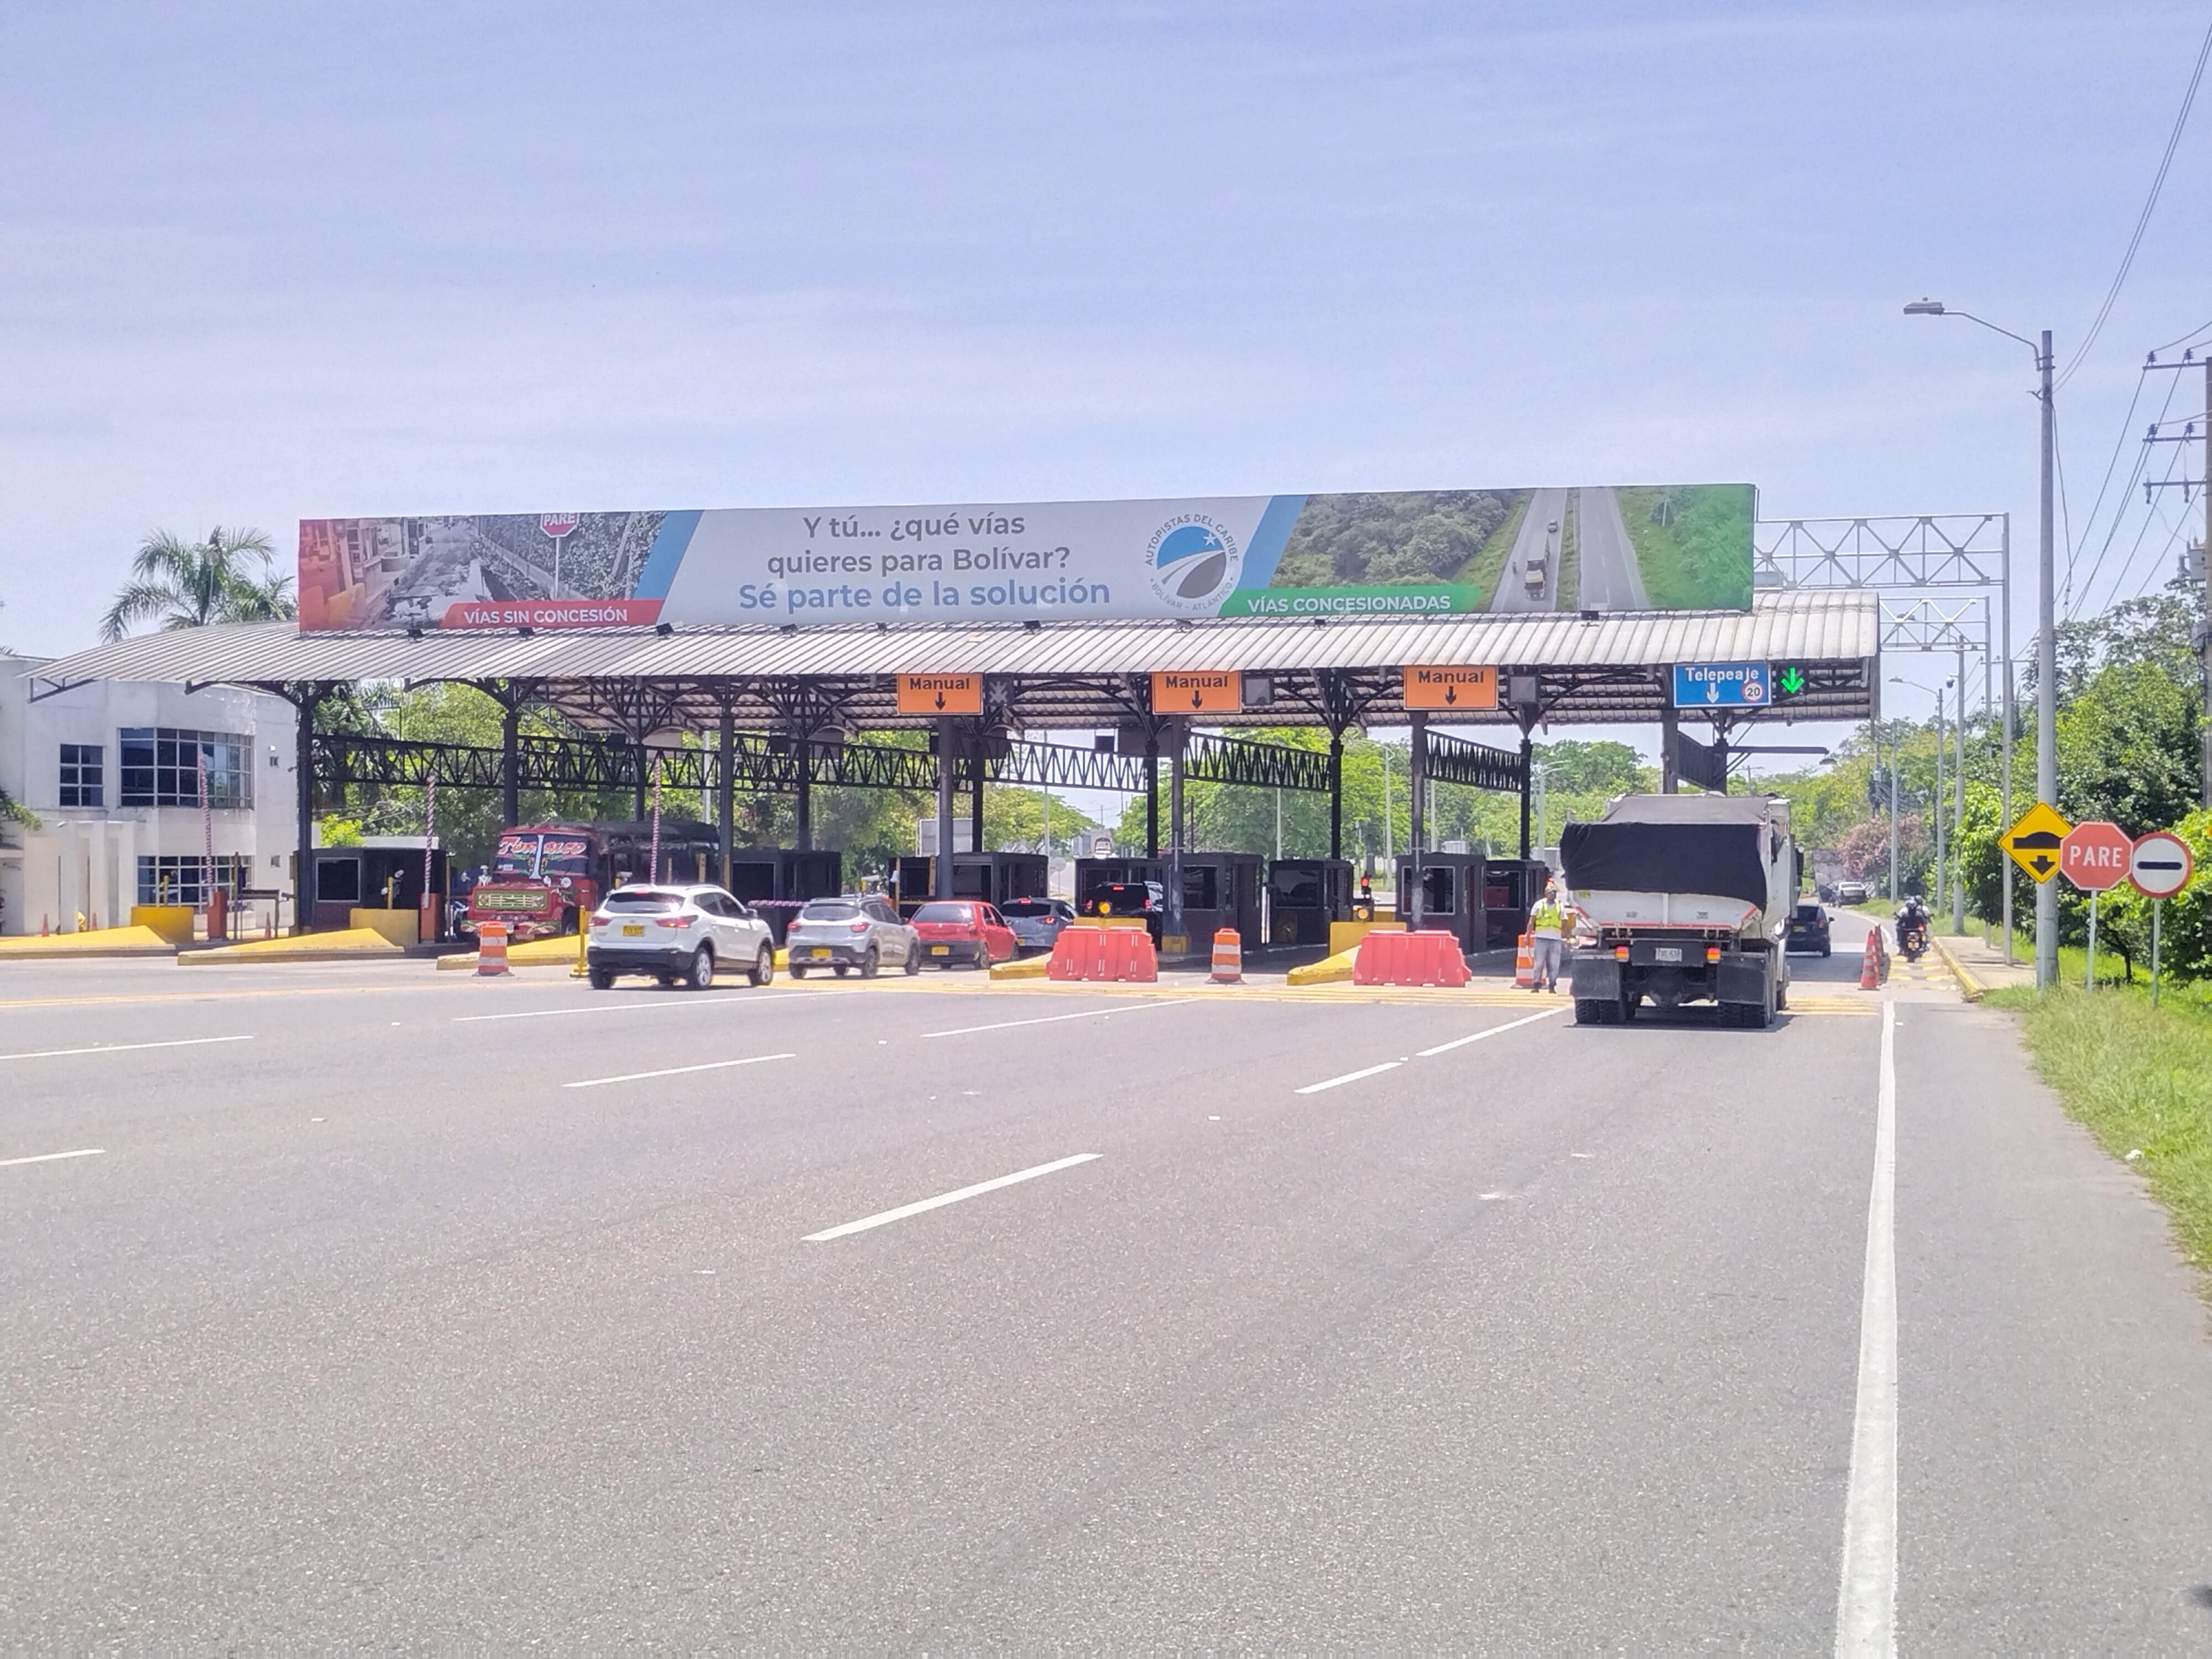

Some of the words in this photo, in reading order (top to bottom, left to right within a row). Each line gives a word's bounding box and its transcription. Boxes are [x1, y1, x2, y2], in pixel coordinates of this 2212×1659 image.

[803, 517, 822, 538] Y
[829, 514, 881, 538] tú...
[890, 512, 959, 541] ¿qué
[968, 512, 1025, 535] vías
[1145, 514, 1191, 566] AUTOPISTAS
[1194, 514, 1213, 527] DEL
[1215, 524, 1239, 562] CARIBE
[768, 550, 872, 579] quieres
[882, 554, 942, 577] para
[953, 546, 1070, 570] Bolívar?
[739, 583, 776, 609] Sé
[788, 585, 872, 614] parte
[883, 581, 922, 607] de
[933, 581, 959, 606] la
[970, 577, 1110, 606] solución
[1248, 596, 1288, 613] VÍAS
[1293, 596, 1451, 612] CONCESIONADAS
[464, 608, 500, 624] VÍAS
[504, 611, 529, 623] SIN
[534, 607, 628, 623] CONCESIÓN
[909, 677, 969, 690] Manual
[1166, 675, 1228, 688] Manual
[1418, 670, 1485, 684] Manual
[1685, 667, 1760, 684] Telepeaje
[1747, 687, 1761, 697] 20
[2069, 846, 2123, 867] PARE
